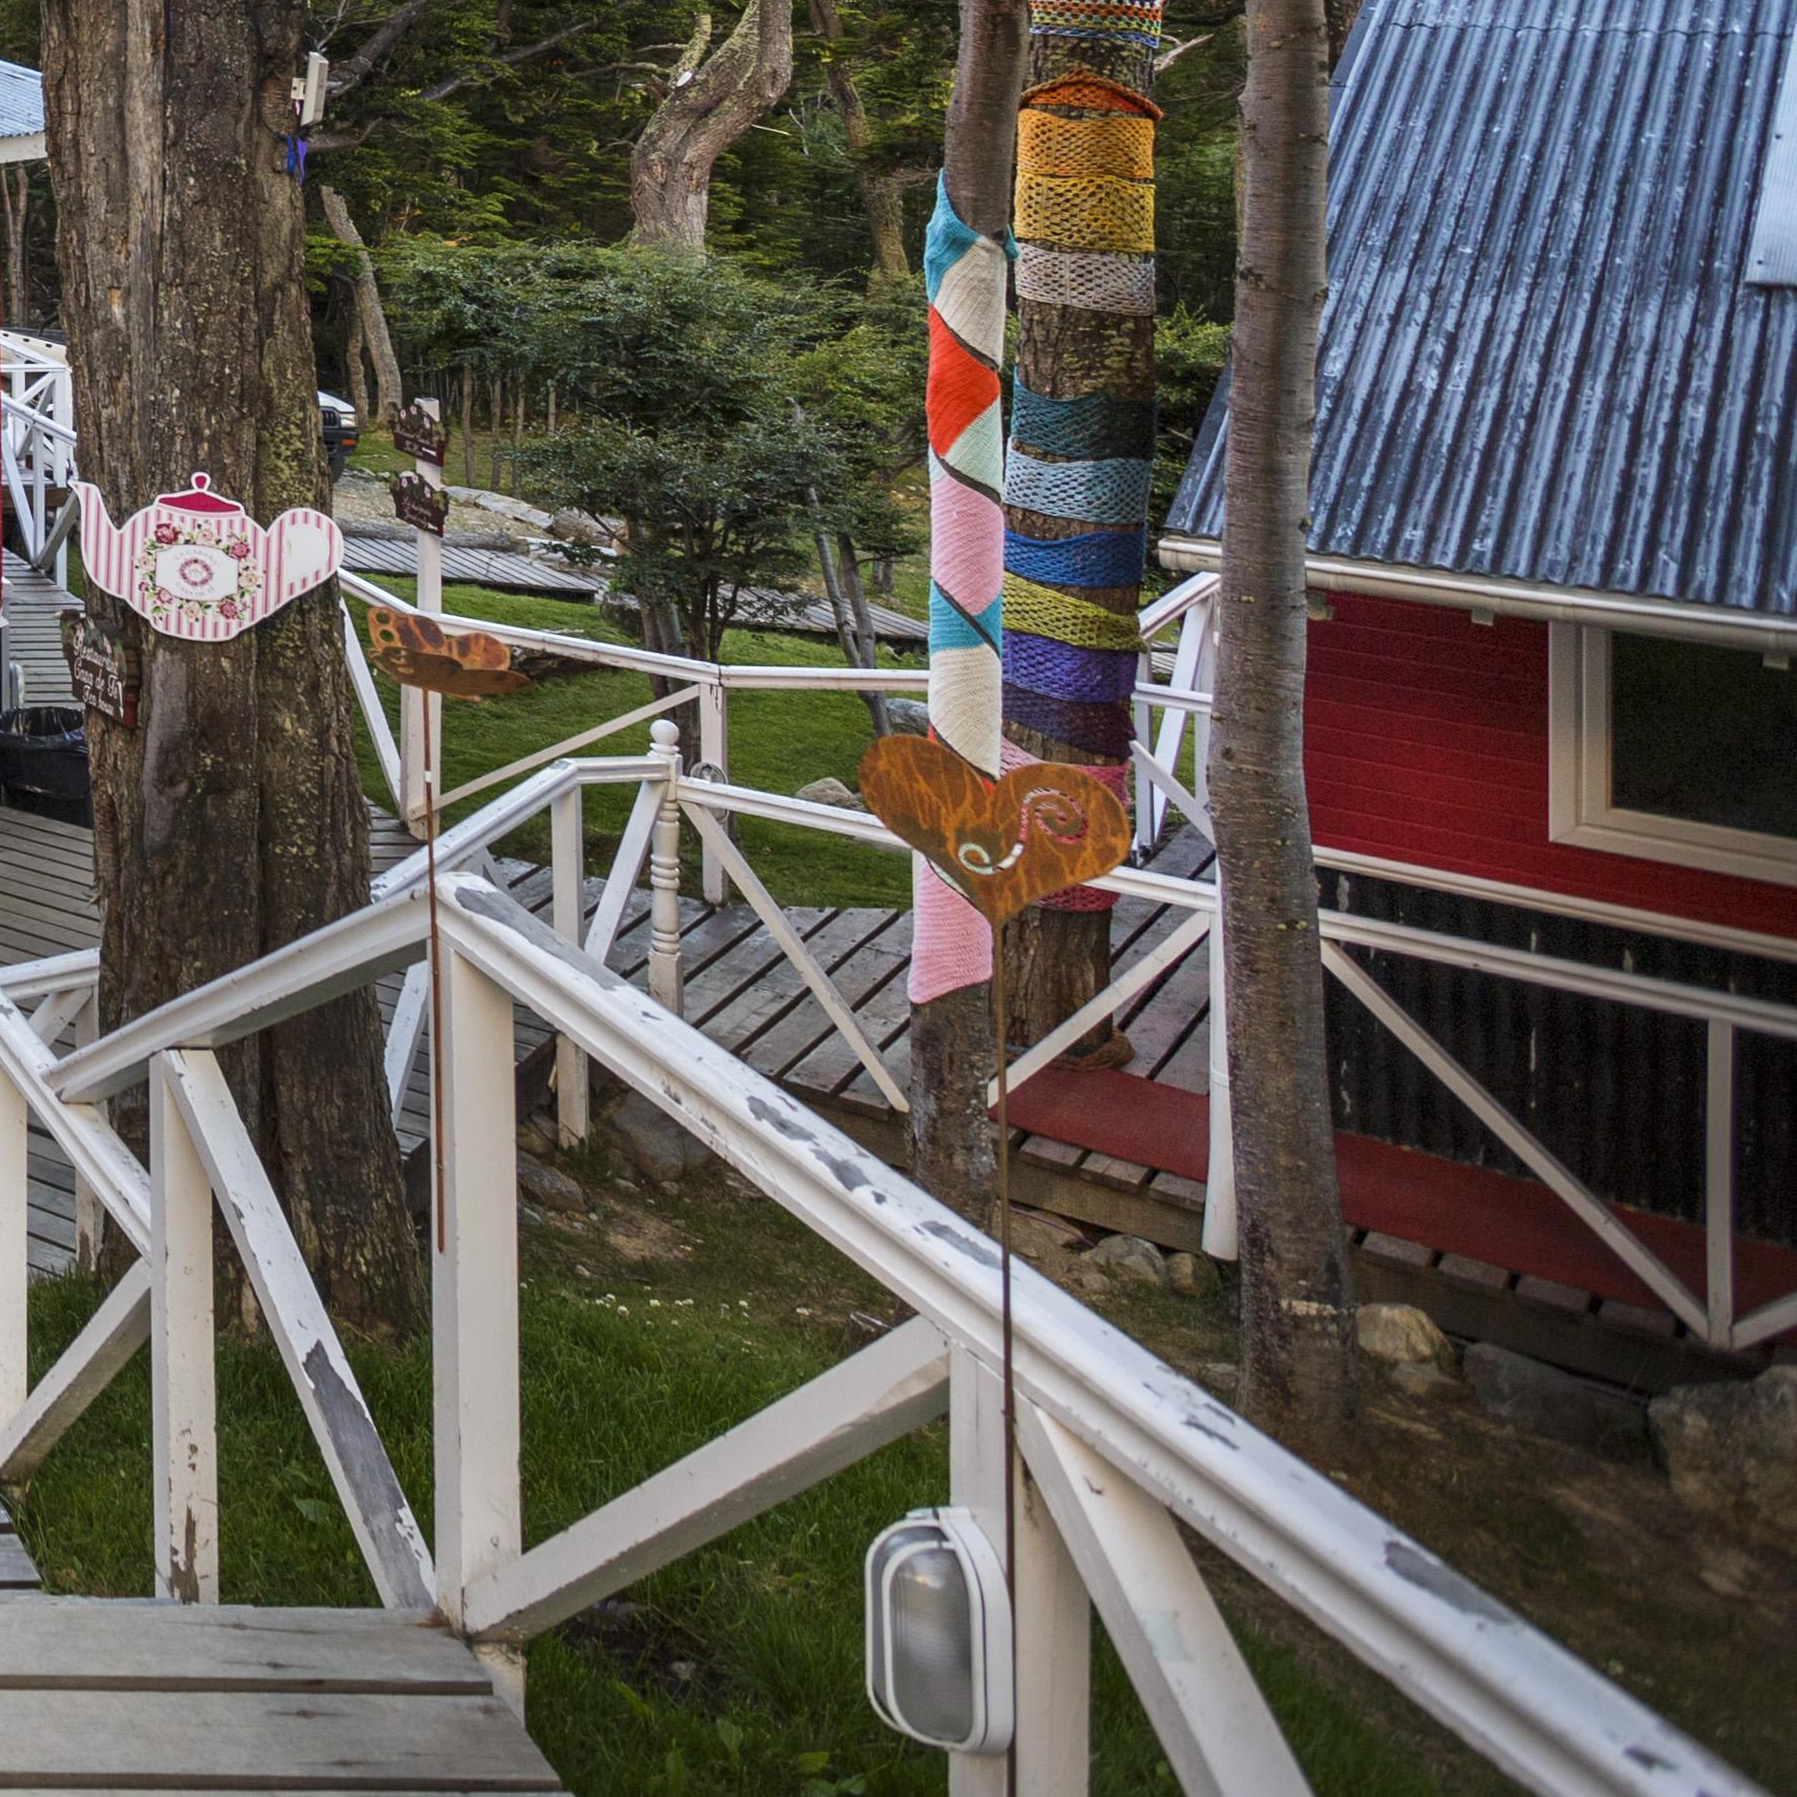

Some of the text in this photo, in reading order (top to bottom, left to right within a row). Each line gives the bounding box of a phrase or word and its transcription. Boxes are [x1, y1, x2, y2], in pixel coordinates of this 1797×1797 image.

[73, 634, 119, 675] Restaurant
[74, 658, 94, 686] Casa
[95, 668, 105, 691] de
